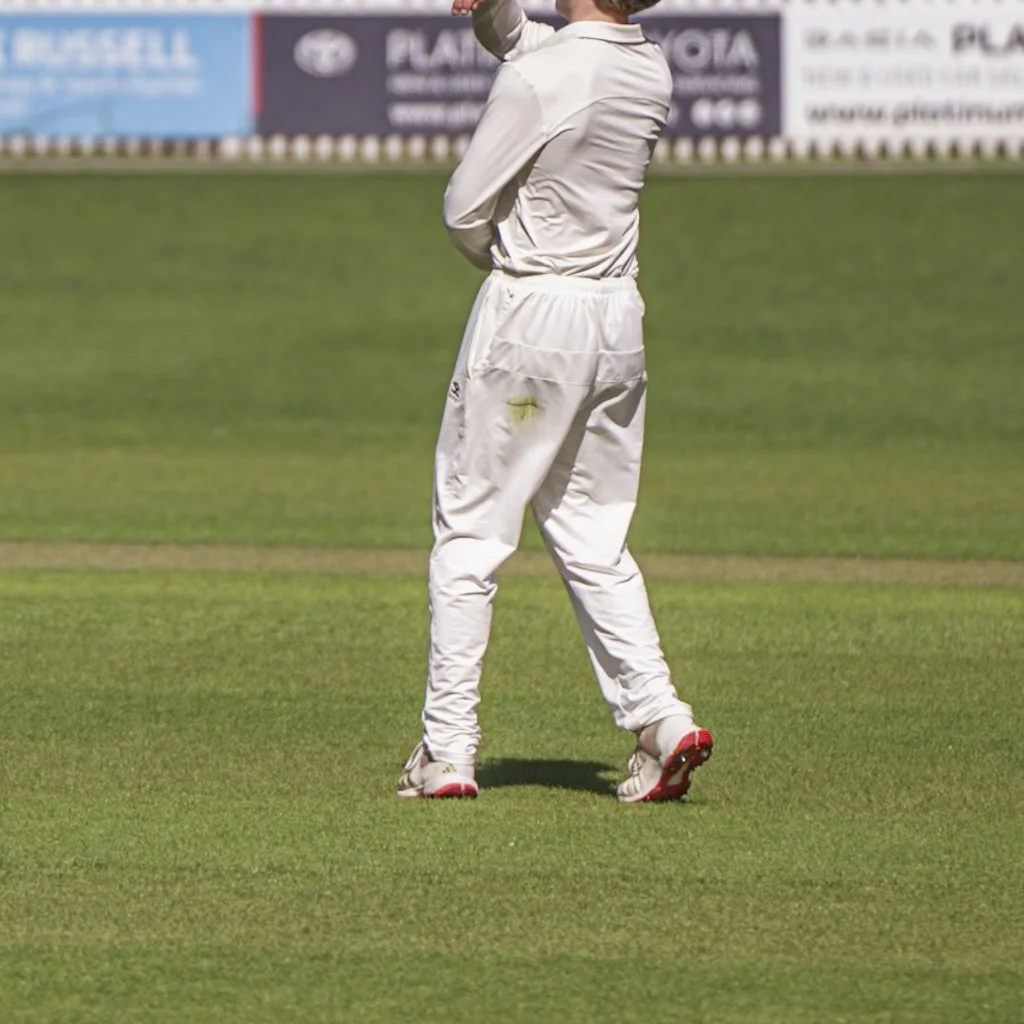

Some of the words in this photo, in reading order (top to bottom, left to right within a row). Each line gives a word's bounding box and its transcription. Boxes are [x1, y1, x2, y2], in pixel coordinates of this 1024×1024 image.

[13, 30, 199, 71] RUSSELL
[387, 28, 498, 72] PLATI
[648, 28, 759, 74] YOTA
